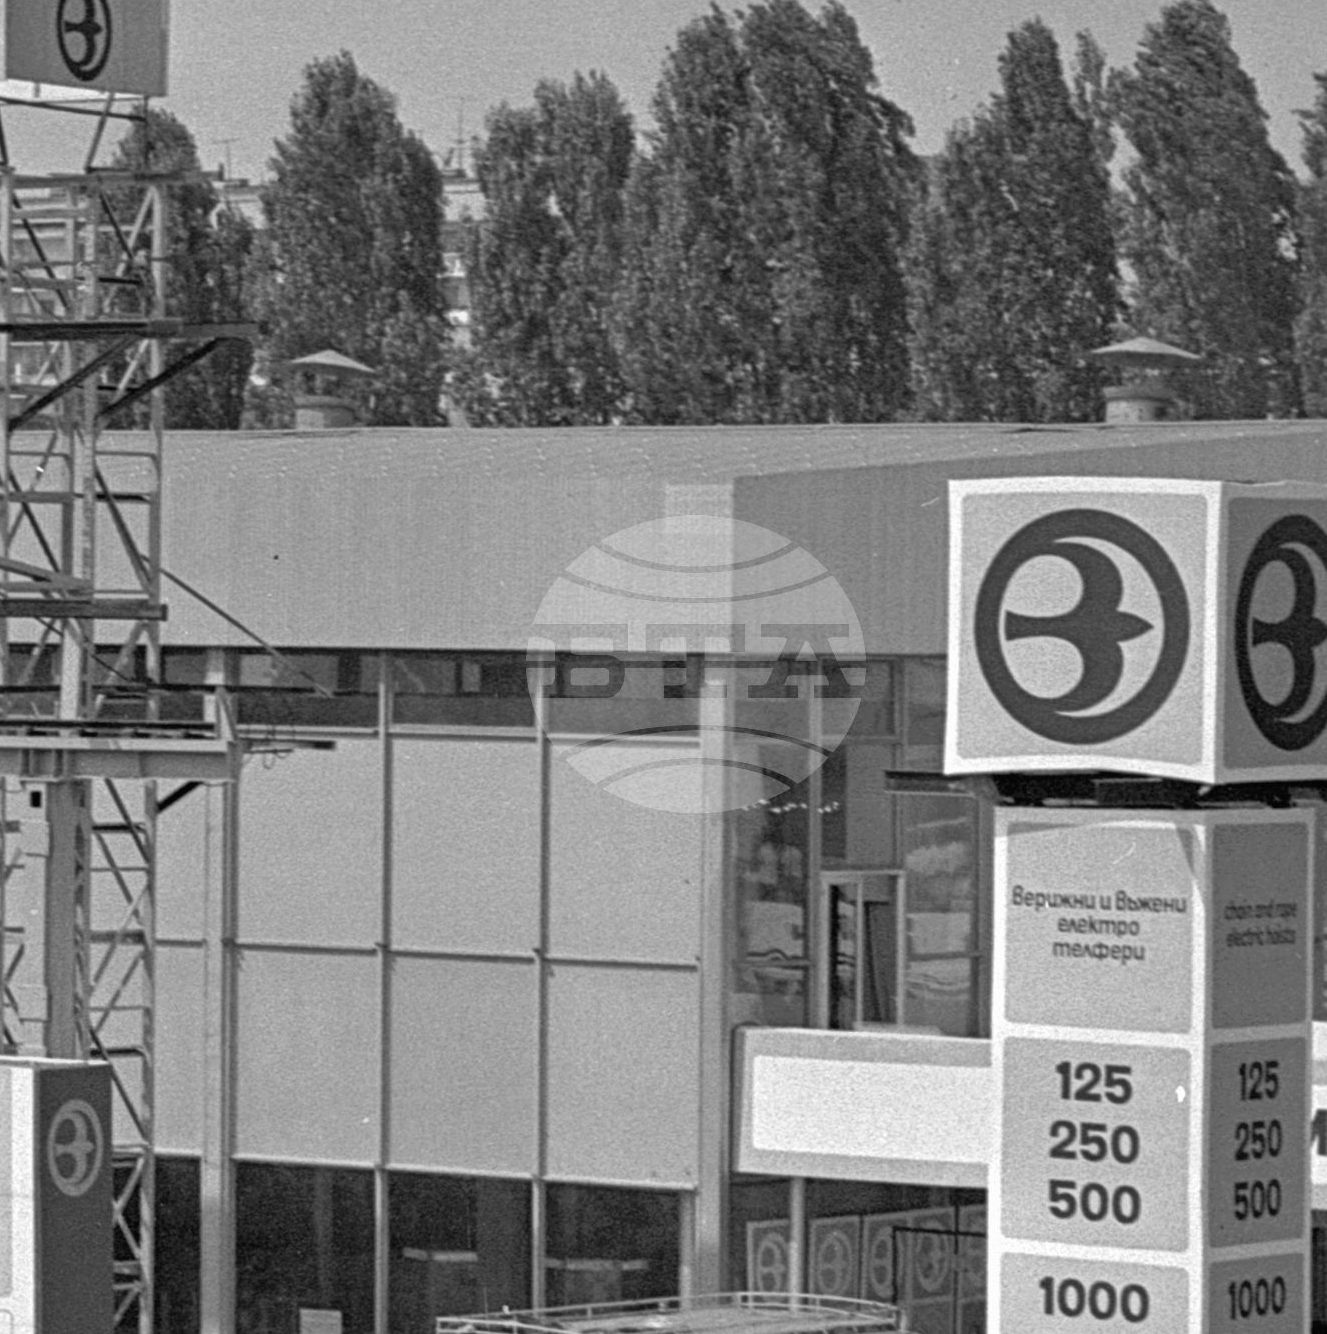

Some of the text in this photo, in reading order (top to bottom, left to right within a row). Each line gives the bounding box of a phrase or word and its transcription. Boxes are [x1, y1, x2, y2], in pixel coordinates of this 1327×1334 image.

[1099, 896, 1112, 911] и
[1055, 1061, 1133, 1105] 125
[1238, 1060, 1279, 1101] 125
[1049, 1120, 1140, 1164] 250
[1234, 1119, 1282, 1162] 250
[1049, 1179, 1141, 1225] 500
[1234, 1178, 1281, 1221] 500
[1039, 1276, 1150, 1324] 1000
[1228, 1276, 1286, 1320] 1000
